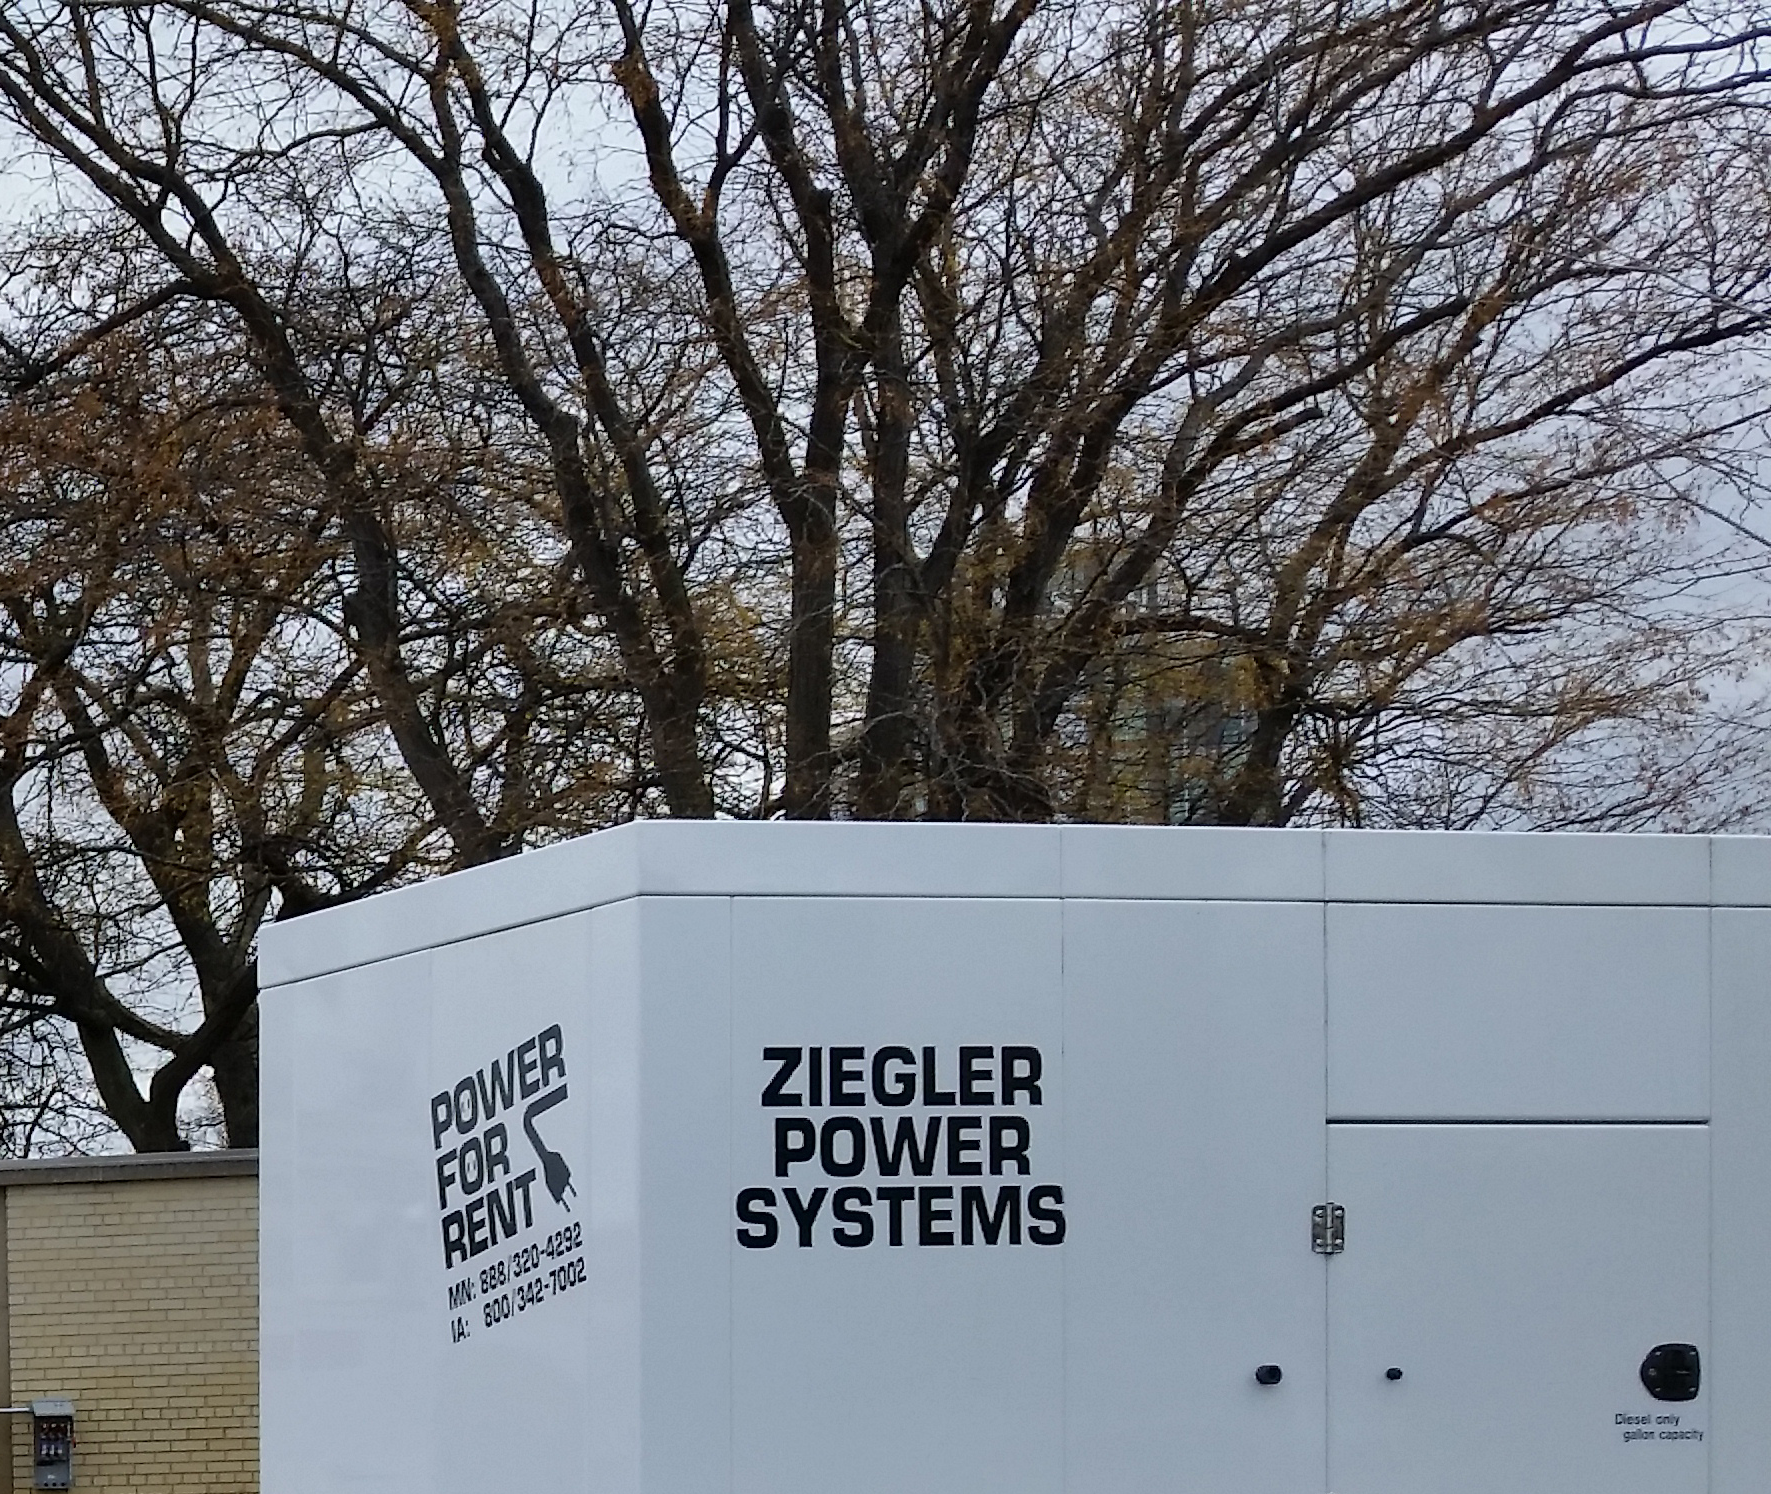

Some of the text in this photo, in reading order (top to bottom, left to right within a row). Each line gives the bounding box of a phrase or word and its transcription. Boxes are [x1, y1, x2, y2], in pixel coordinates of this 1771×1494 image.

[431, 1023, 567, 1150] POWER
[761, 1045, 1043, 1107] ZIEGLER
[436, 1121, 510, 1210] FOR
[774, 1115, 1032, 1178] POWER
[441, 1168, 537, 1269] RENT
[735, 1184, 1067, 1249] SYSTEMS
[447, 1221, 583, 1311] MN: 888/320-4292
[451, 1256, 588, 1344] IA: 800/342-7002
[1615, 1413, 1680, 1426] Diesel only
[1623, 1428, 1704, 1442] gallon capacity
